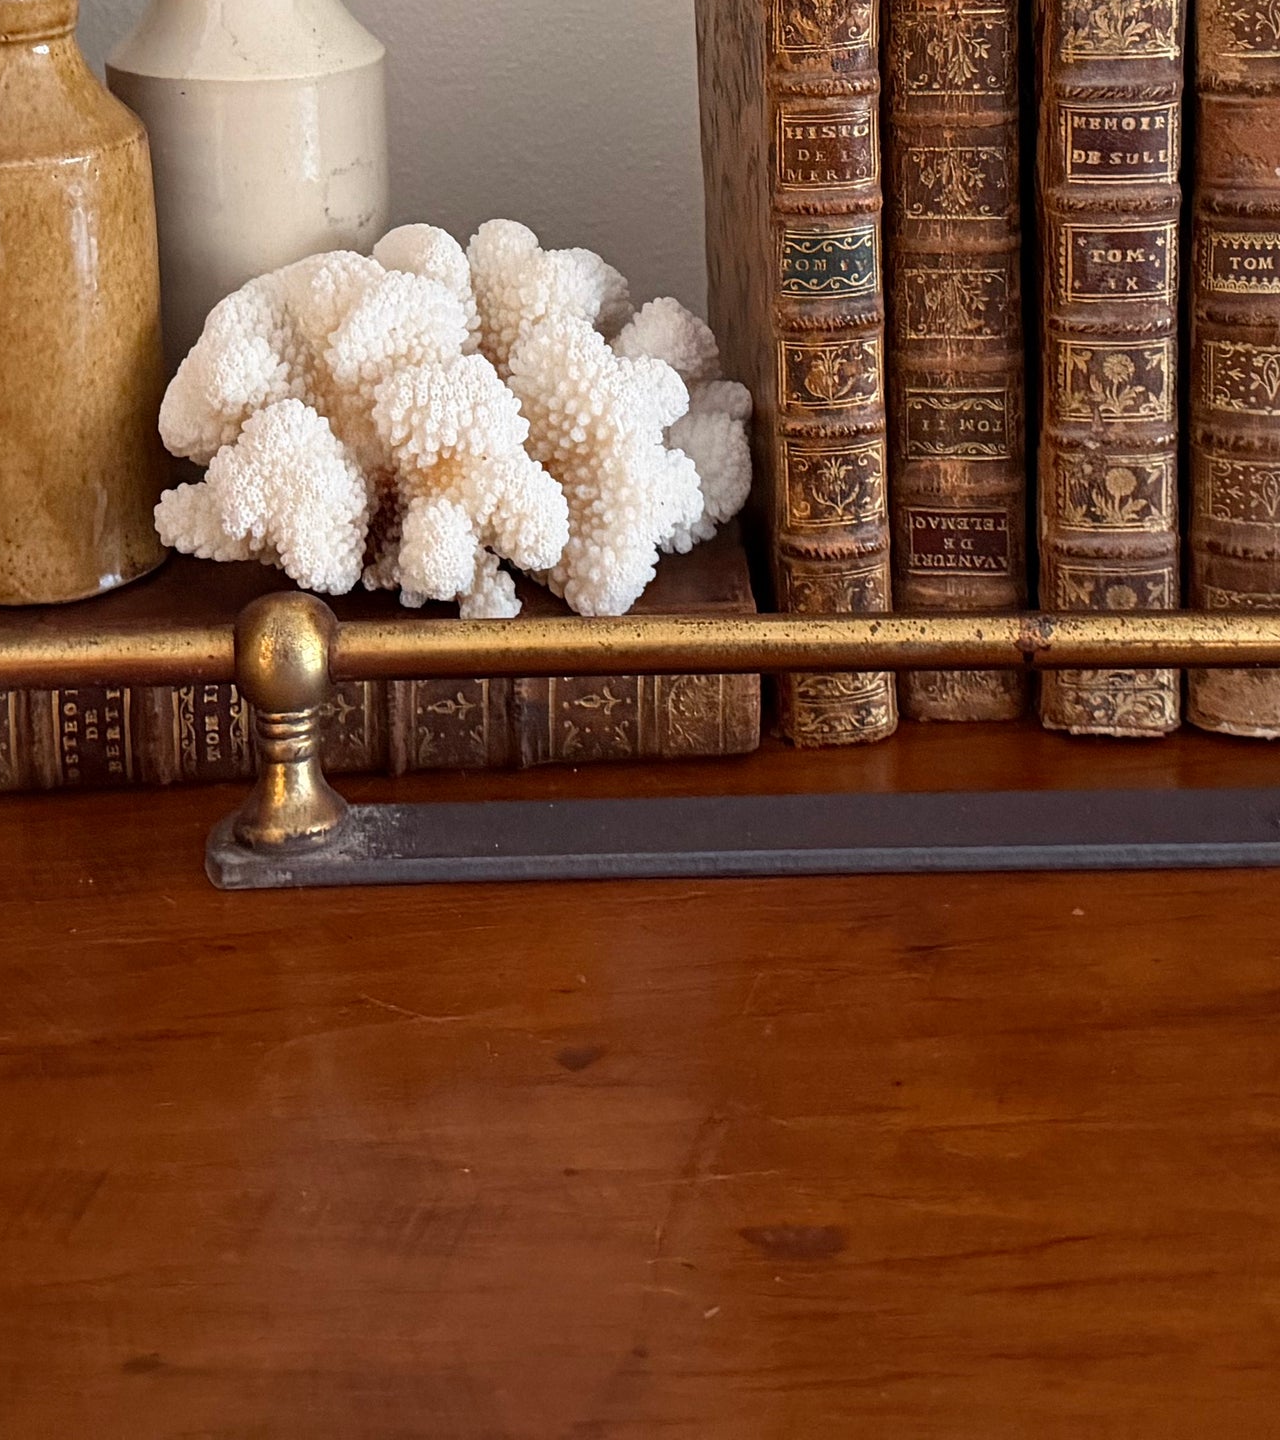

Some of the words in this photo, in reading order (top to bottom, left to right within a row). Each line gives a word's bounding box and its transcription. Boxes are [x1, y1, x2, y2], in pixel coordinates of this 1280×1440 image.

[785, 123, 869, 140] HISTO
[797, 149, 827, 162] DE
[1072, 149, 1101, 165] DE
[782, 258, 827, 271] TOM
[1230, 257, 1274, 270] TOM
[959, 418, 1003, 432] TOM
[85, 708, 98, 740] DE
[205, 714, 221, 761] TOM
